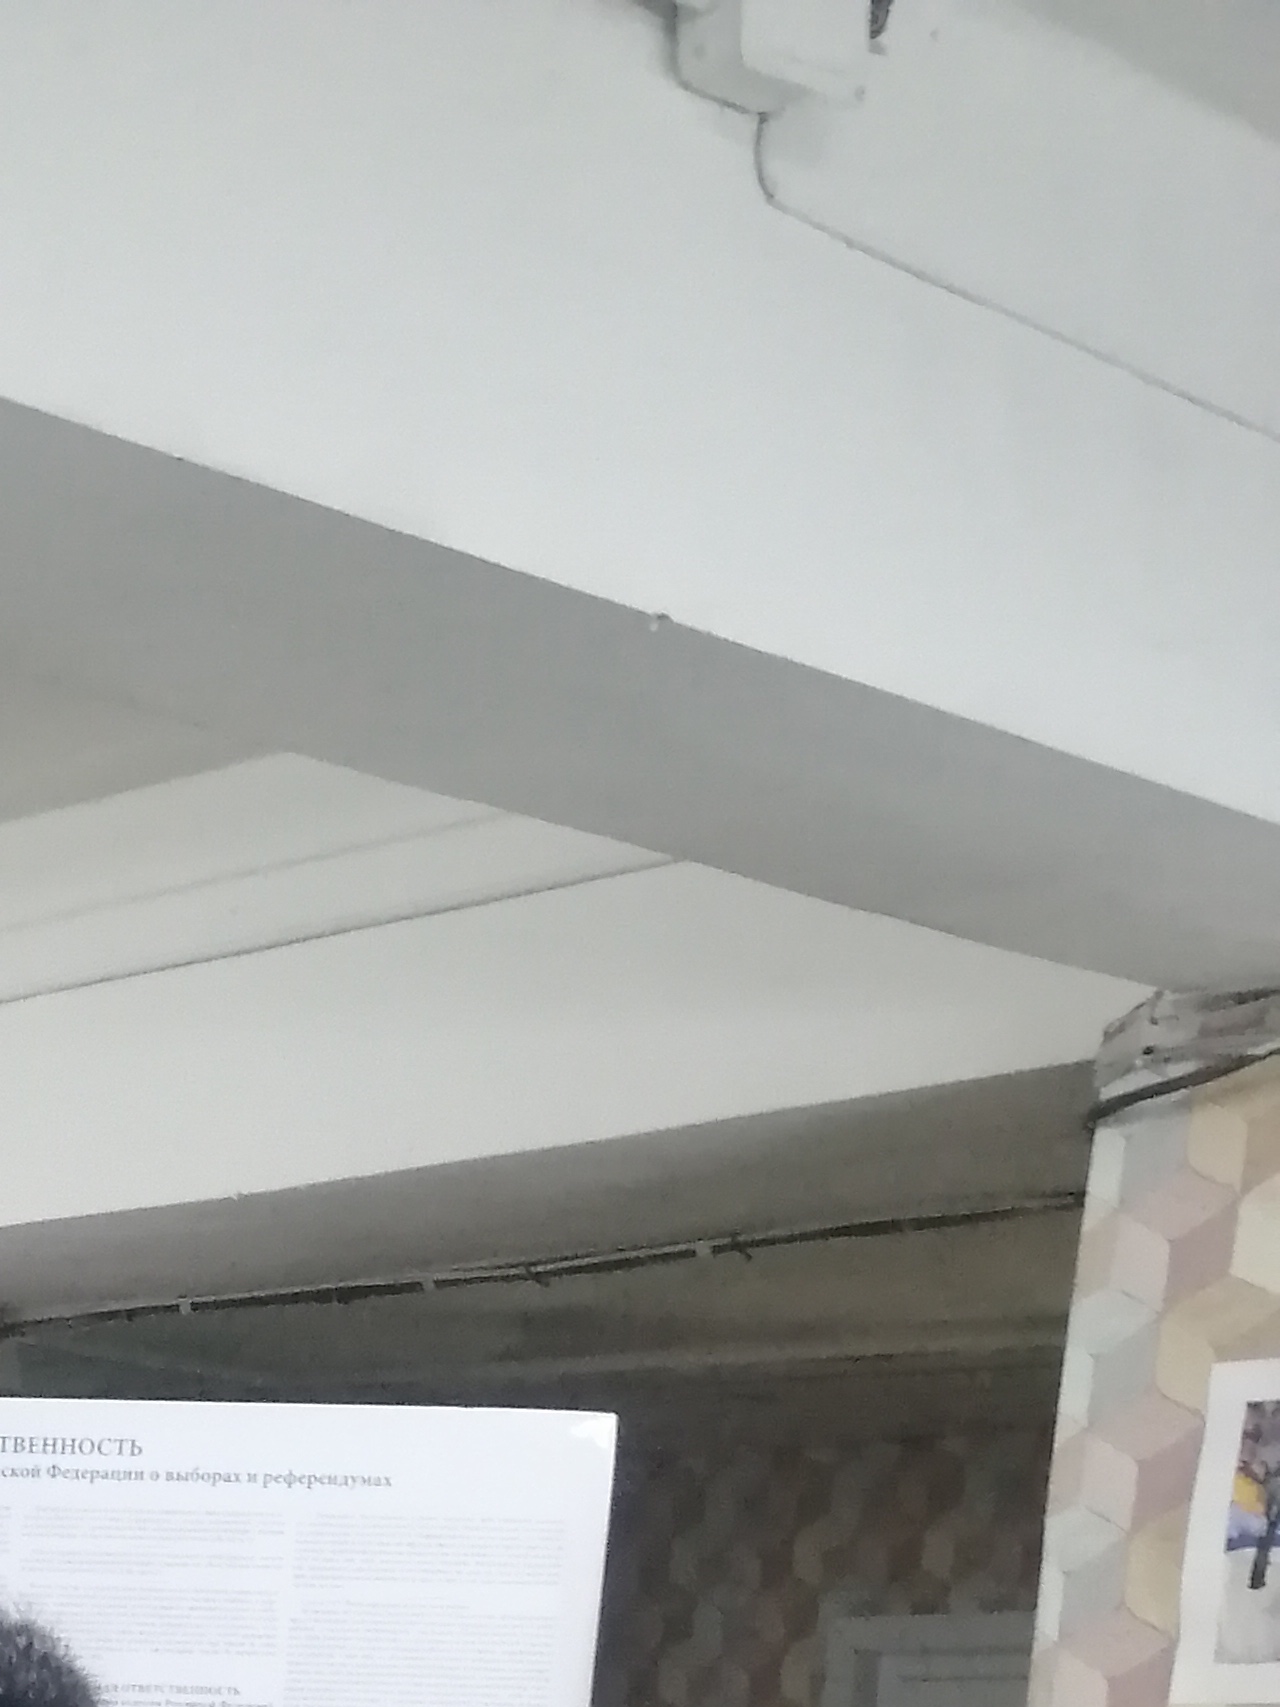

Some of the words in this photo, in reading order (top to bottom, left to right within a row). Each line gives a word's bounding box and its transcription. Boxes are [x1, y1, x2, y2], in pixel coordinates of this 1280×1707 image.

[46, 1464, 145, 1482] Федерации
[149, 1470, 160, 1481] о
[165, 1467, 242, 1484] выборах
[247, 1471, 258, 1483] и
[263, 1470, 393, 1489] референдумах
